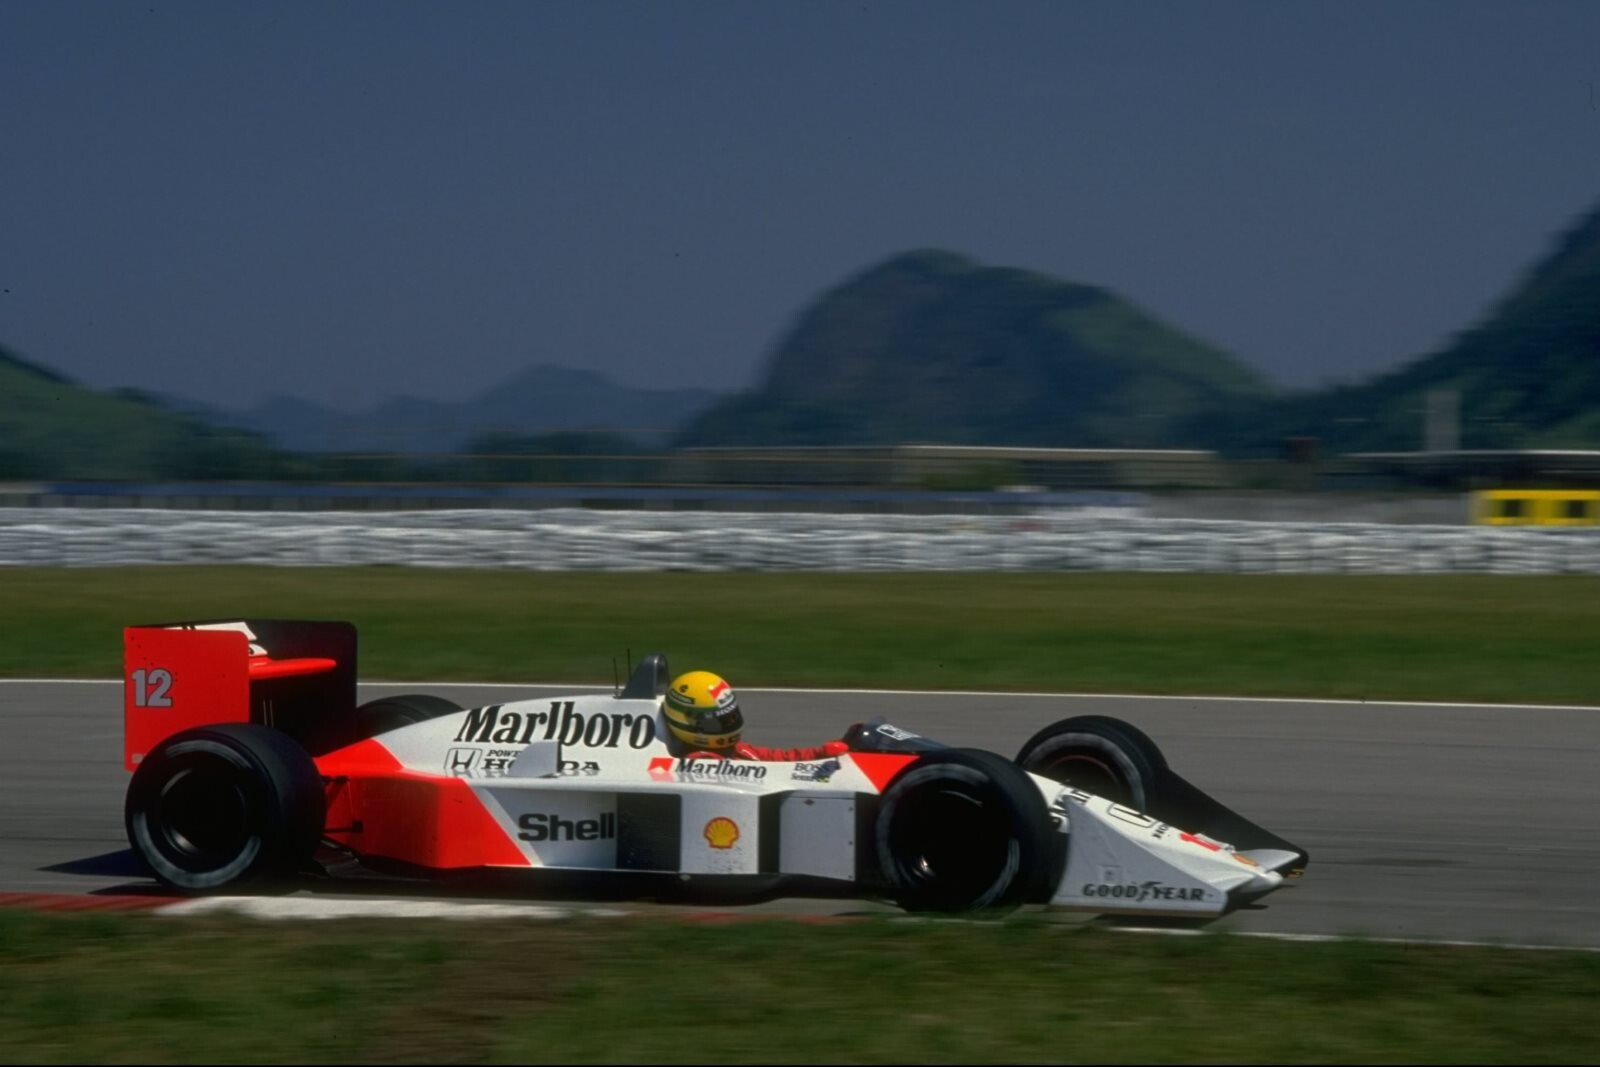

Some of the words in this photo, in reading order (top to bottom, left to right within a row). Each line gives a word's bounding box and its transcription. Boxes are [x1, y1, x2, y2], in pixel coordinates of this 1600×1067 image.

[131, 668, 173, 707] 12
[453, 701, 656, 749] Marlboro
[675, 757, 767, 779] Marlboro
[518, 812, 615, 841] Shell
[1082, 881, 1205, 902] GOODYEAR
